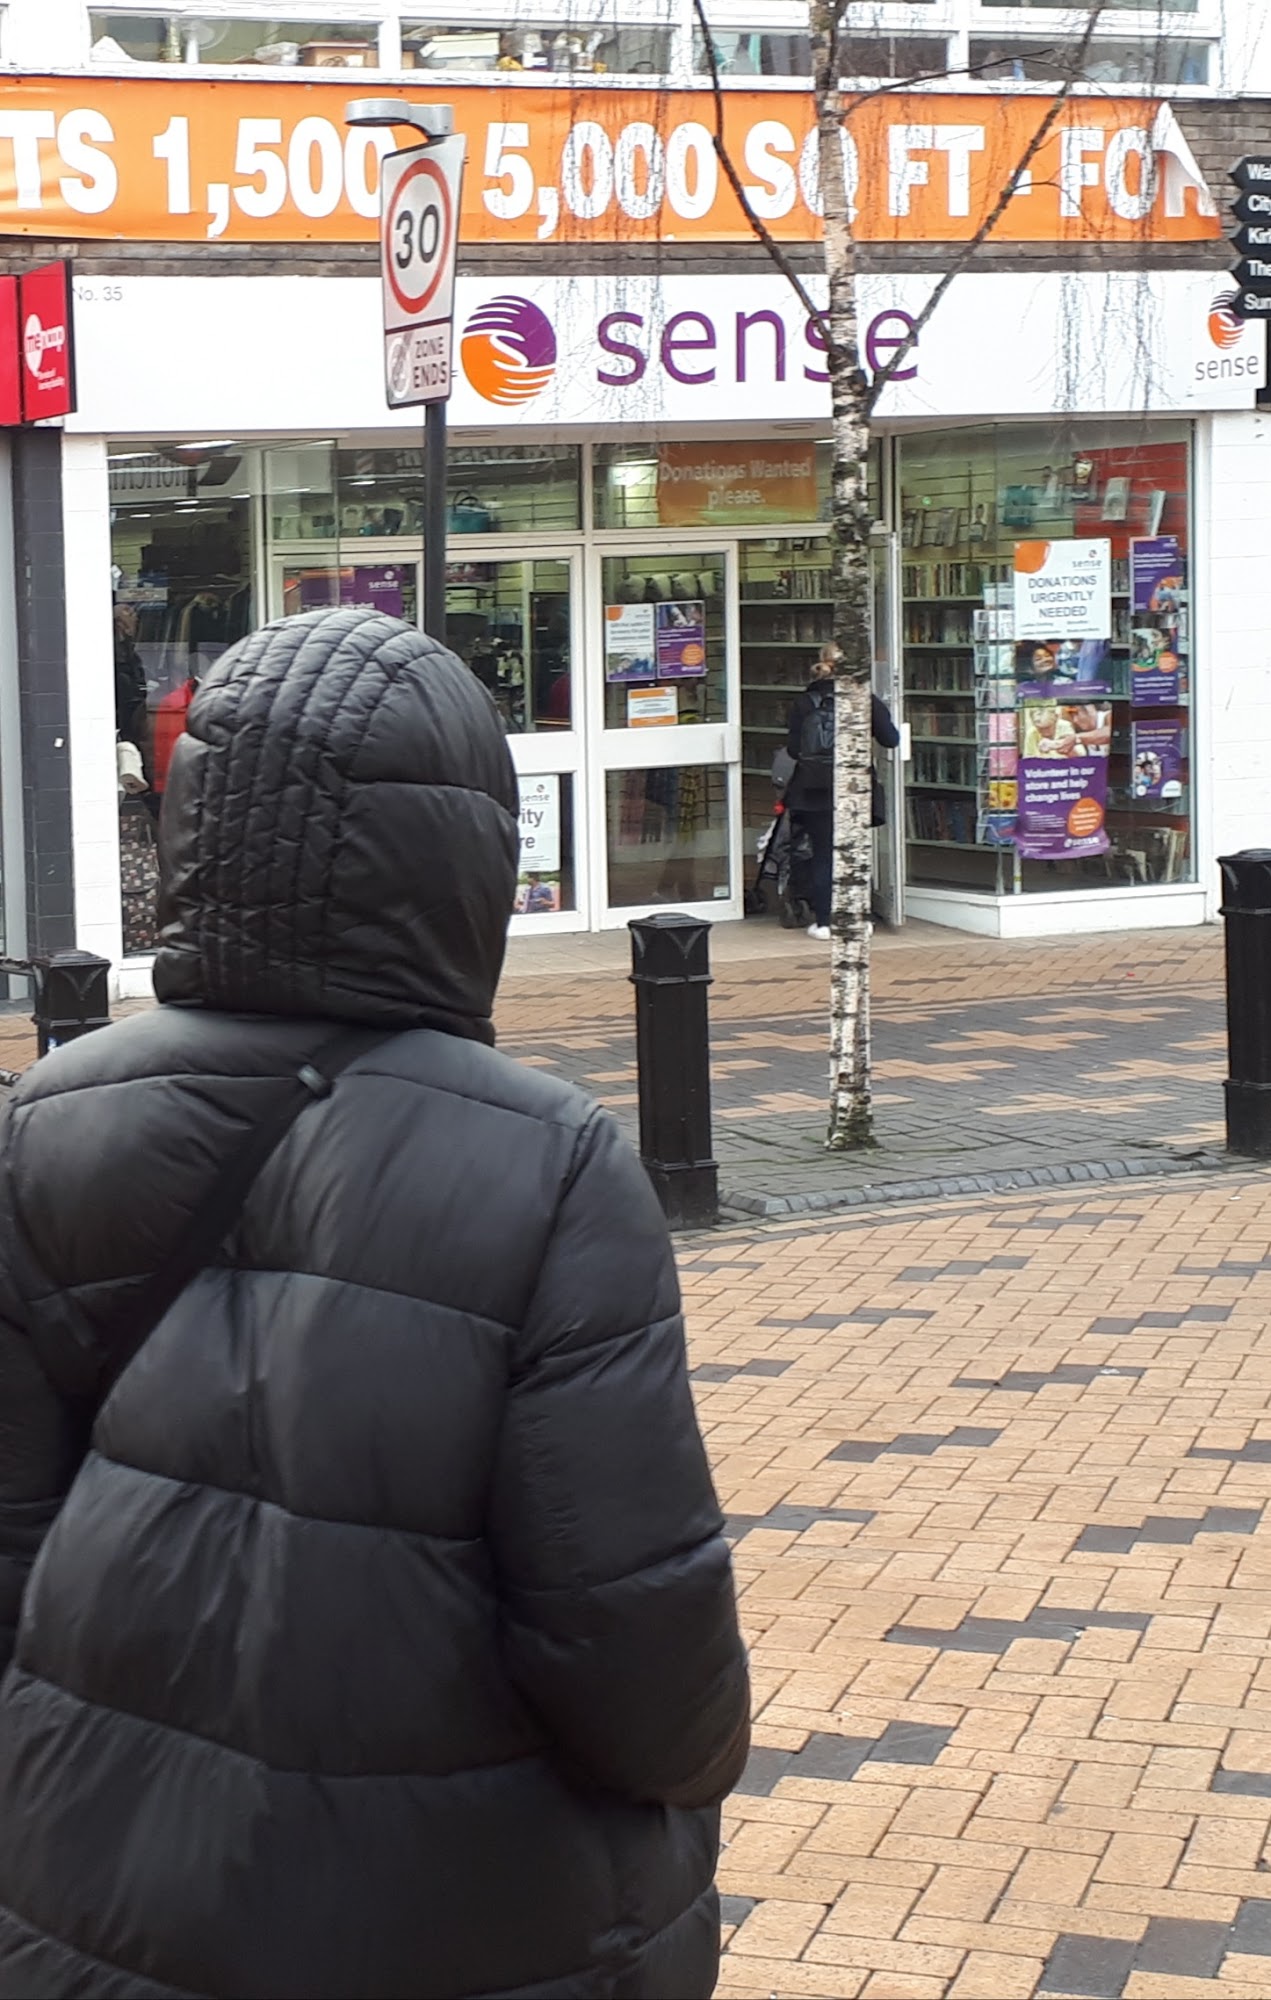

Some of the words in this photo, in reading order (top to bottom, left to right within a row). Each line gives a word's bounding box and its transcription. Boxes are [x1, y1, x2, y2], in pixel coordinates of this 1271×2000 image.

[483, 121, 717, 240] 5,000
[888, 124, 985, 217] FT
[395, 204, 440, 269] 30
[103, 286, 123, 301] 35
[416, 336, 443, 358] ZONE
[597, 310, 918, 386] sense
[414, 361, 447, 388] ENDS
[1195, 355, 1259, 381] sense
[660, 460, 746, 481] Donations
[750, 457, 811, 478] Wanted
[707, 486, 766, 509] please.
[1072, 559, 1102, 568] sense
[368, 580, 399, 589] sense
[1028, 575, 1097, 588] DONATIONS
[1031, 590, 1094, 603] URGENTLY
[1039, 606, 1087, 618] NEEDED
[1024, 768, 1069, 778] Volunteer
[1070, 767, 1079, 775] in
[1081, 767, 1096, 775] our
[1025, 782, 1049, 790] store
[1051, 779, 1068, 789] and
[1069, 778, 1088, 789] help
[520, 794, 550, 802] sense
[1025, 793, 1059, 803] change
[1060, 791, 1081, 800] lives
[520, 808, 544, 828] ity
